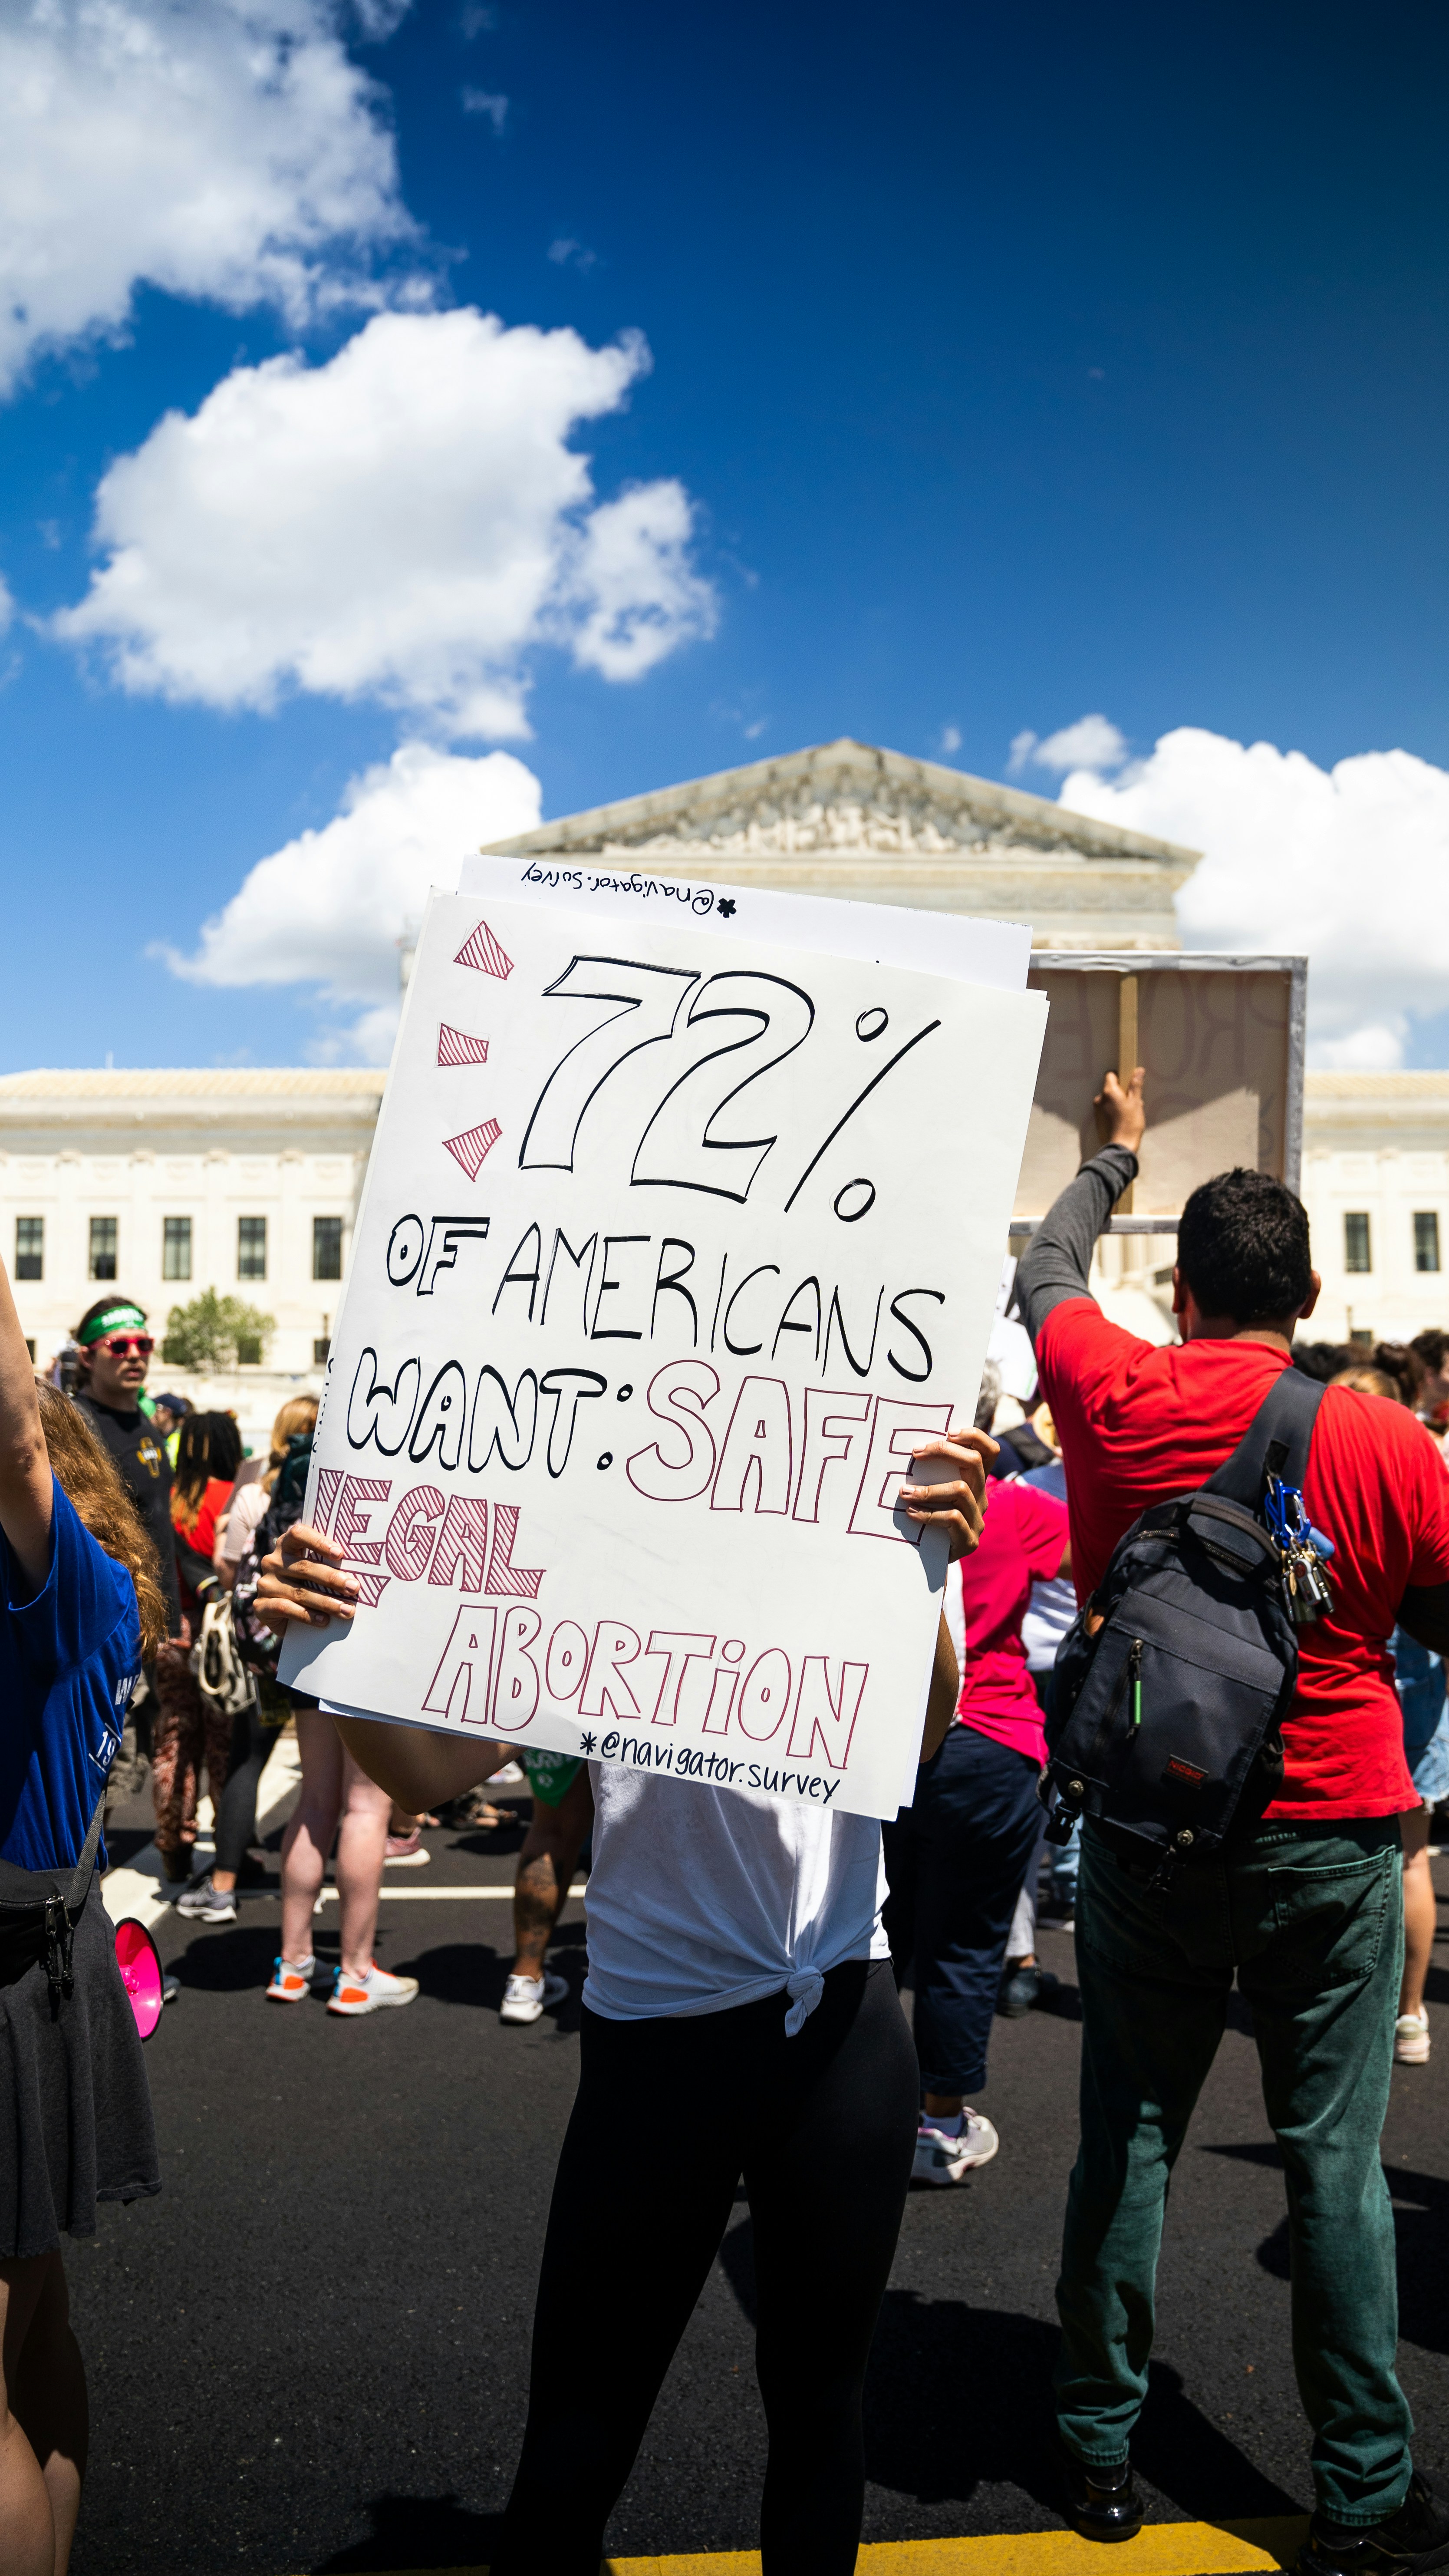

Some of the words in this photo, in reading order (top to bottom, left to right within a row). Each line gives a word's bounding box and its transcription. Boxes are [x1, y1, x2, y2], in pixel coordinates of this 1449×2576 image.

[517, 954, 942, 1223] 72%
[386, 1213, 491, 1297] OF
[491, 1221, 946, 1383] AMERICANS
[346, 1346, 634, 1480] WANT:
[626, 1360, 952, 1545] SAFE
